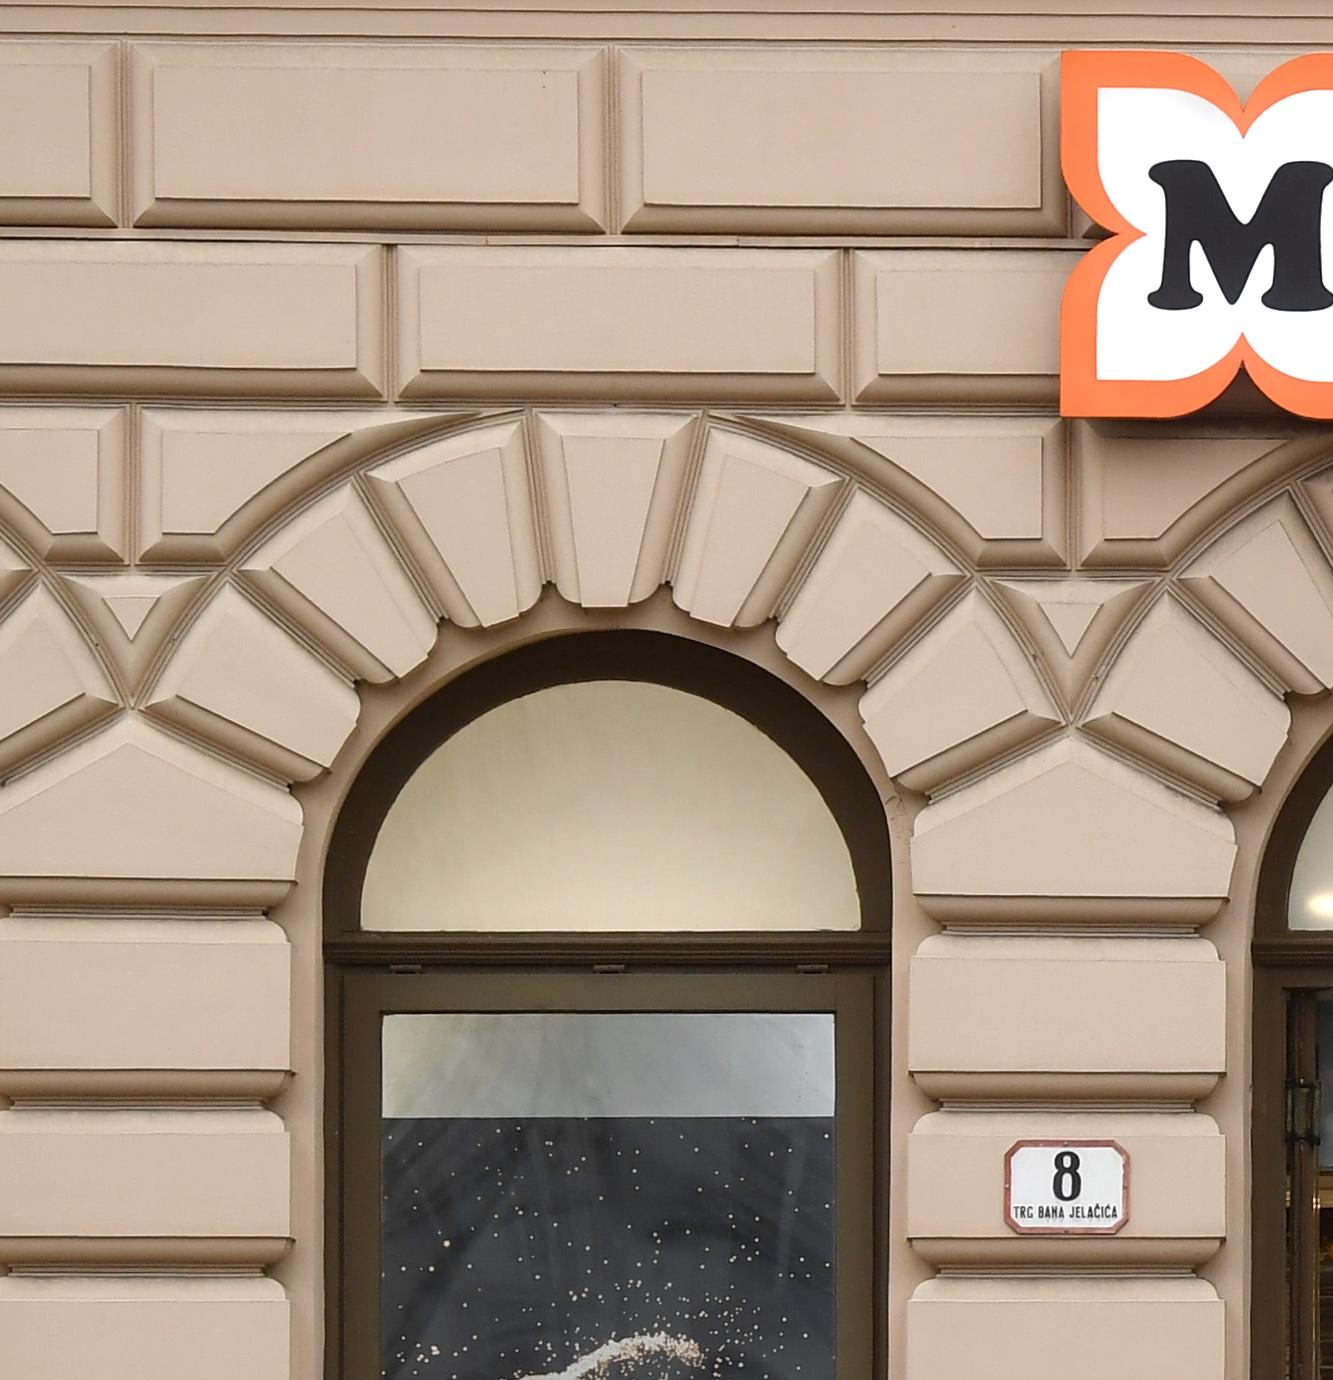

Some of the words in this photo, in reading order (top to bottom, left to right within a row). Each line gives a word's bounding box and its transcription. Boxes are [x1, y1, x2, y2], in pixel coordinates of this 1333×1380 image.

[1052, 1150, 1082, 1202] 8
[1013, 1205, 1034, 1219] TRG
[1038, 1205, 1065, 1219] BANA
